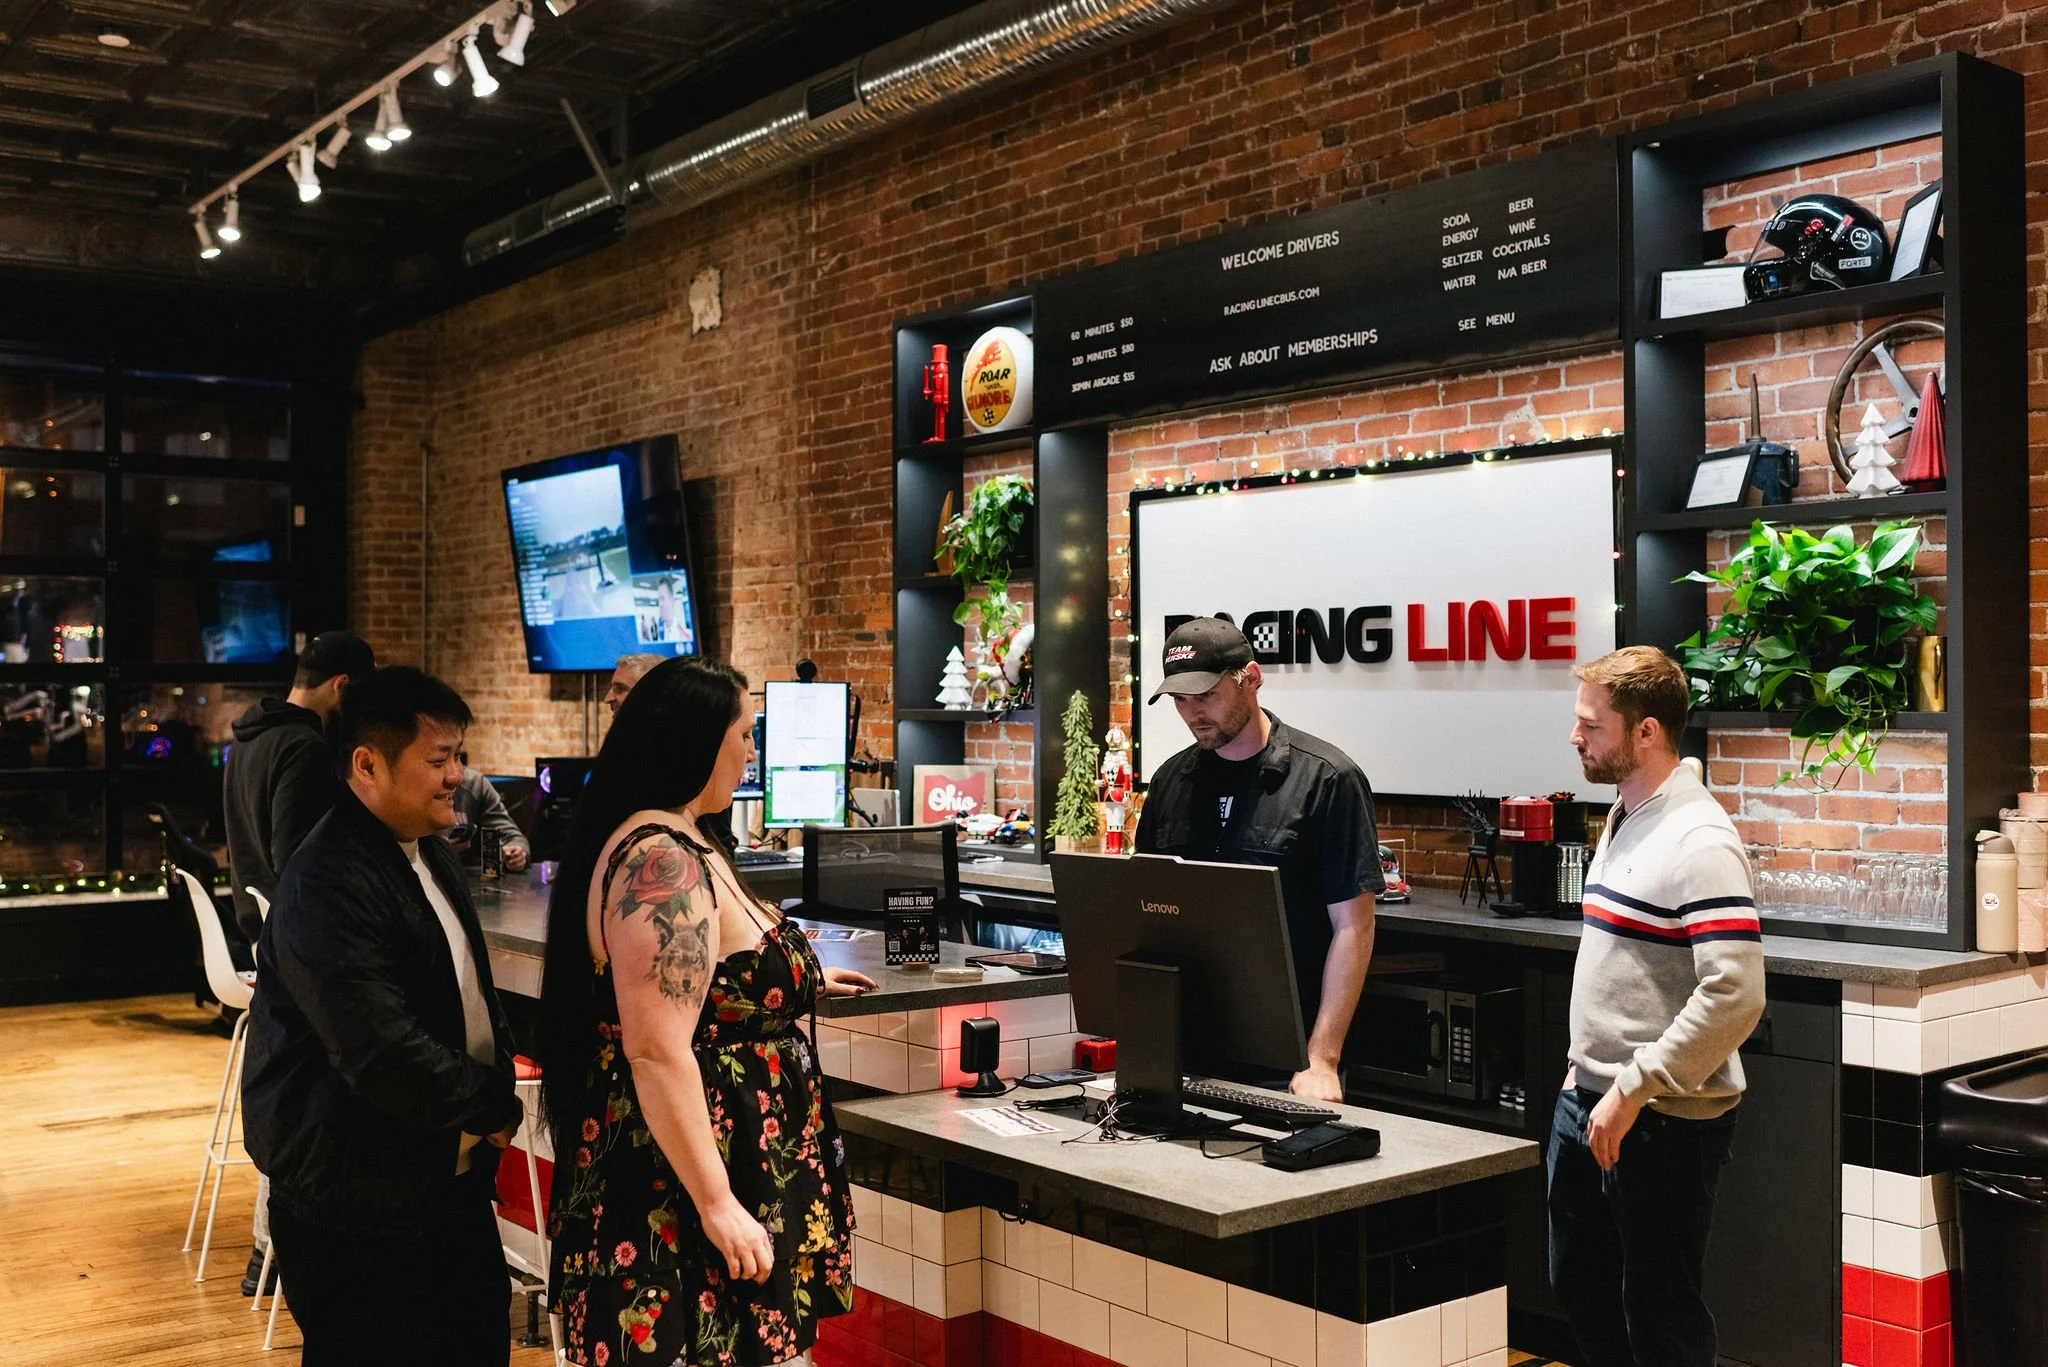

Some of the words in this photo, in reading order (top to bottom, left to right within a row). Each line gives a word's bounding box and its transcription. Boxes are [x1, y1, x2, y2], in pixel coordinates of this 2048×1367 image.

[1508, 197, 1534, 213] BEER
[1442, 213, 1471, 229] SODA
[1508, 218, 1536, 235] WINE
[1442, 227, 1479, 246] ENERGY
[1492, 233, 1551, 258] COCKTAILS
[1221, 243, 1284, 271] WELCOME
[1287, 230, 1340, 255] DRIVERS
[1441, 249, 1483, 269] SELTZER
[1497, 266, 1518, 281] N/A
[1521, 259, 1547, 275] BEER
[1443, 274, 1476, 291] WATER
[1070, 331, 1080, 341] 60
[1084, 322, 1115, 338] MINUTES
[1120, 316, 1134, 328] $50
[1458, 318, 1477, 331] SEE
[1485, 312, 1515, 327] MENU
[1072, 355, 1084, 366] 120
[1086, 347, 1118, 363] MINUTES
[1121, 343, 1135, 354] $80
[1209, 356, 1232, 373] ASK
[1239, 346, 1280, 366] ABOUT
[1288, 328, 1378, 358] MEMBERSHIPS
[979, 368, 1011, 384] ROAR
[1093, 375, 1120, 388] ARCADE
[1123, 371, 1135, 382] $35
[1164, 605, 1393, 664] CING
[1407, 597, 1576, 662] LINE
[1168, 645, 1193, 656] TEAM
[928, 783, 978, 812] Ohio
[888, 897, 914, 906] HAVING
[915, 896, 934, 906] FUN?
[1141, 899, 1180, 915] Lenovo
